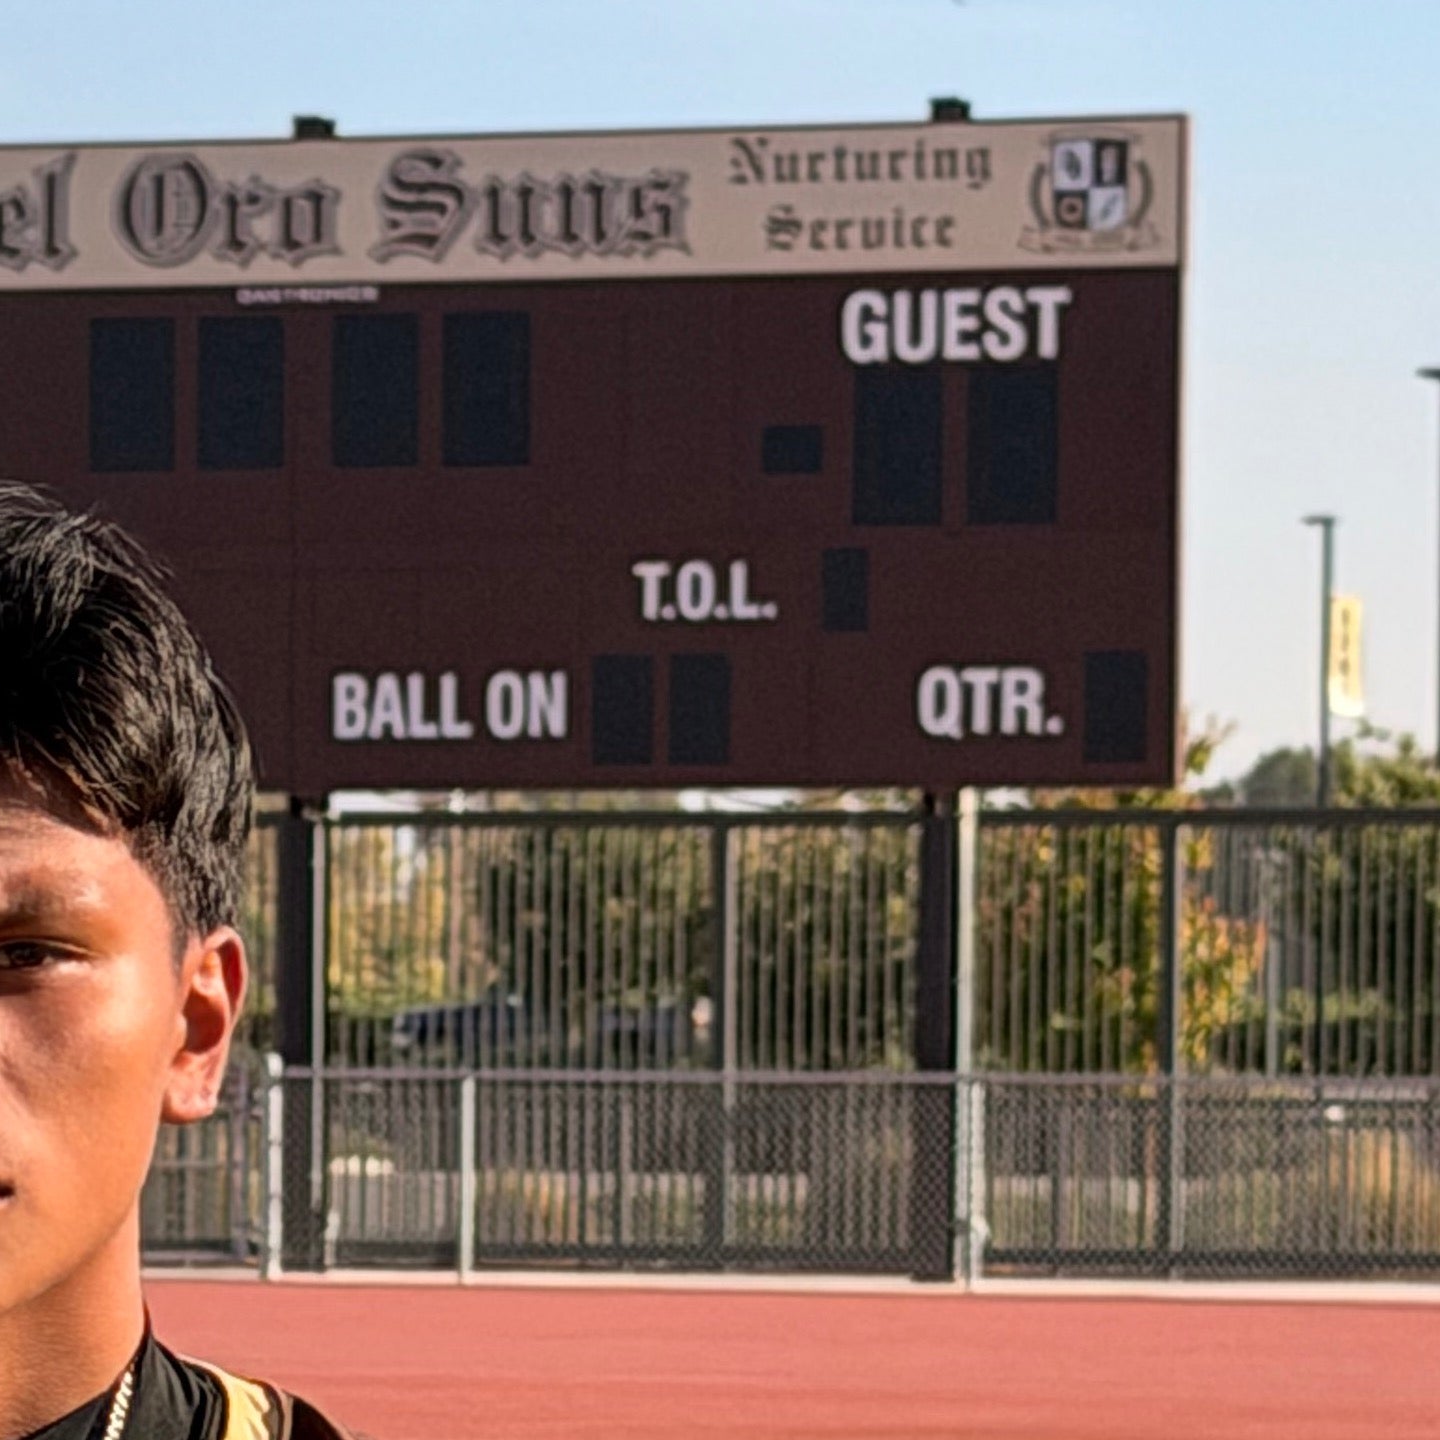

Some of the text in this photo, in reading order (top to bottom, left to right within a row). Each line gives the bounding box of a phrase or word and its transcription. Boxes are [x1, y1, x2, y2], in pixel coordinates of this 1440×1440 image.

[728, 134, 993, 191] Nurturing
[110, 151, 344, 269] Oro
[366, 148, 694, 264] Suns
[764, 202, 956, 251] Service
[842, 286, 1072, 364] GUEST
[632, 560, 778, 621] T.O.L.
[332, 671, 567, 741] BALL ON
[917, 666, 1064, 740] QTR.
